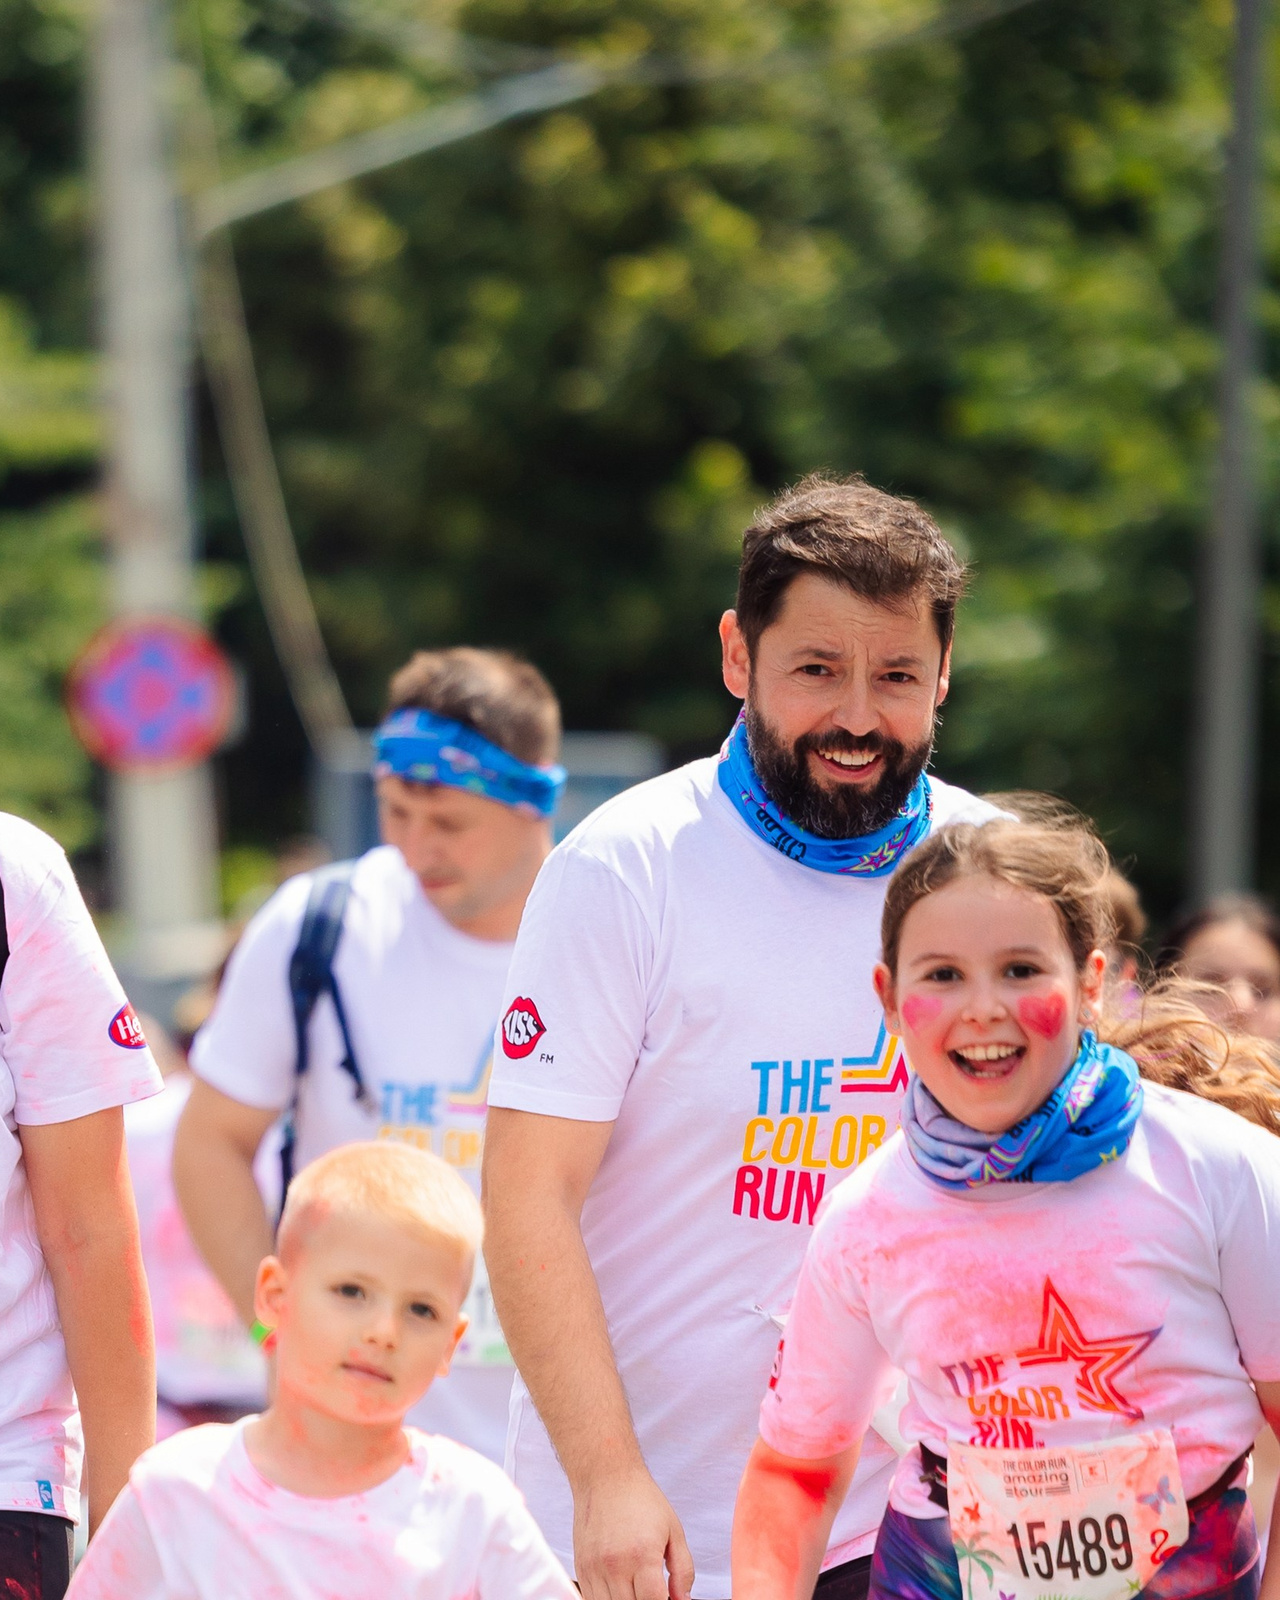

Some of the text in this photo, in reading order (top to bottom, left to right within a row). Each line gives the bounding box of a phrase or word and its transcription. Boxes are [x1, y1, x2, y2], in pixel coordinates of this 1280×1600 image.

[539, 1053, 554, 1064] FM
[751, 1058, 835, 1115] THE
[742, 1115, 887, 1169] COLOR
[732, 1165, 826, 1226] RUN
[939, 1353, 1008, 1398] THE
[967, 1386, 1070, 1421] COLOR
[1003, 1460, 1016, 1471] THE
[1017, 1460, 1046, 1471] COLOR
[1003, 1471, 1069, 1486] amazing
[1013, 1486, 1043, 1497] tour
[1006, 1513, 1134, 1581] 15489
